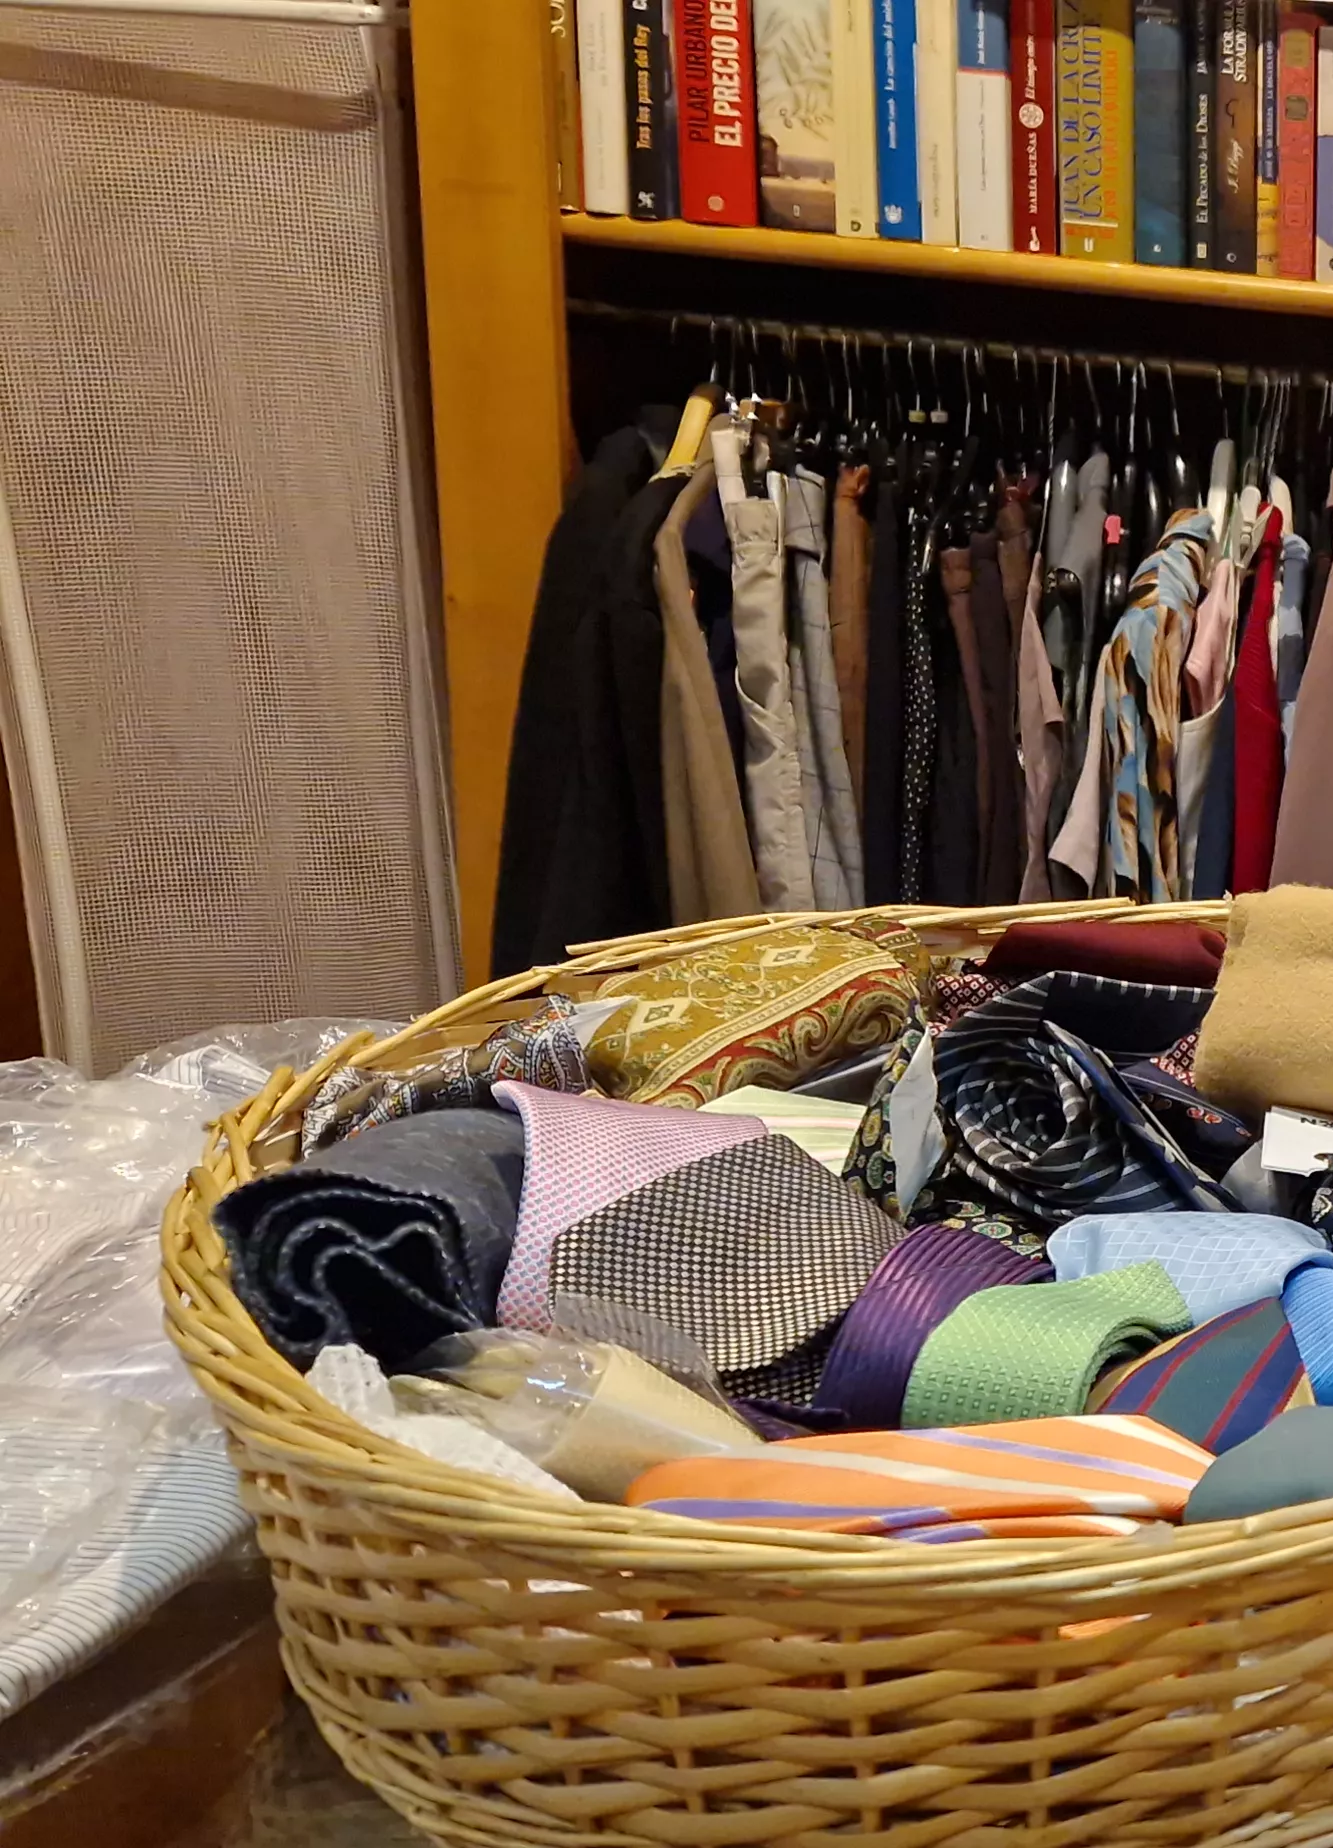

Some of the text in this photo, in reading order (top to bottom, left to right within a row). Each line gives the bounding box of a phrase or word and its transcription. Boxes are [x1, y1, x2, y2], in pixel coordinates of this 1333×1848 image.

[633, 24, 651, 47] Rey
[635, 49, 651, 68] del
[1220, 57, 1234, 74] LA
[636, 70, 653, 103] pasos
[710, 36, 743, 147] EL PRECIO
[636, 107, 651, 123] los
[686, 87, 709, 142] PILAR
[637, 126, 651, 149] Tras
[1061, 70, 1081, 213] JUAN DE LA
[1025, 132, 1038, 213] MARÍA DUEÑAS
[1079, 111, 1103, 218] UN CASO
